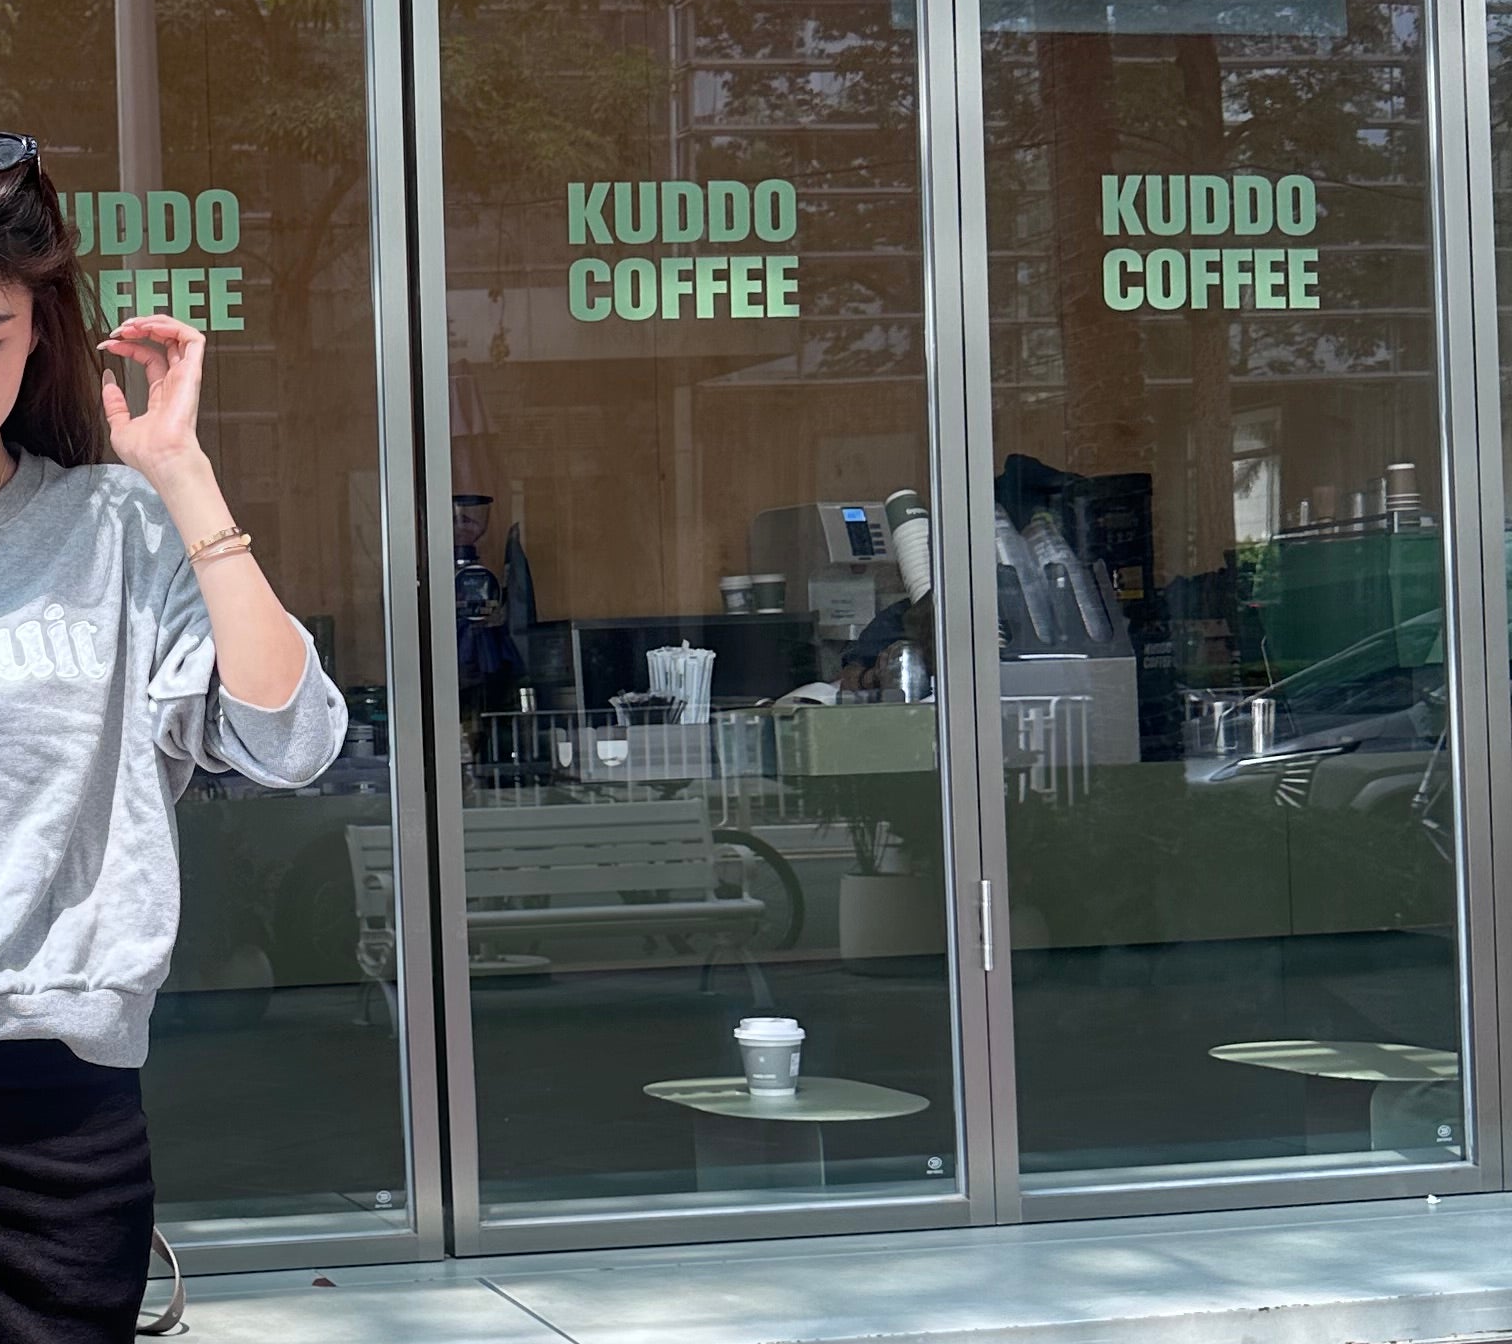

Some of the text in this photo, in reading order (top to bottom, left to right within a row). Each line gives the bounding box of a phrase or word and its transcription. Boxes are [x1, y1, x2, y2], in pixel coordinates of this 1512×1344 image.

[57, 189, 240, 256] UDDO
[567, 179, 797, 245] KUDDO
[1102, 174, 1317, 236] KUDDO
[78, 267, 245, 333] FFEE
[568, 255, 800, 322] COFFEE
[1102, 248, 1321, 310] COFFEE
